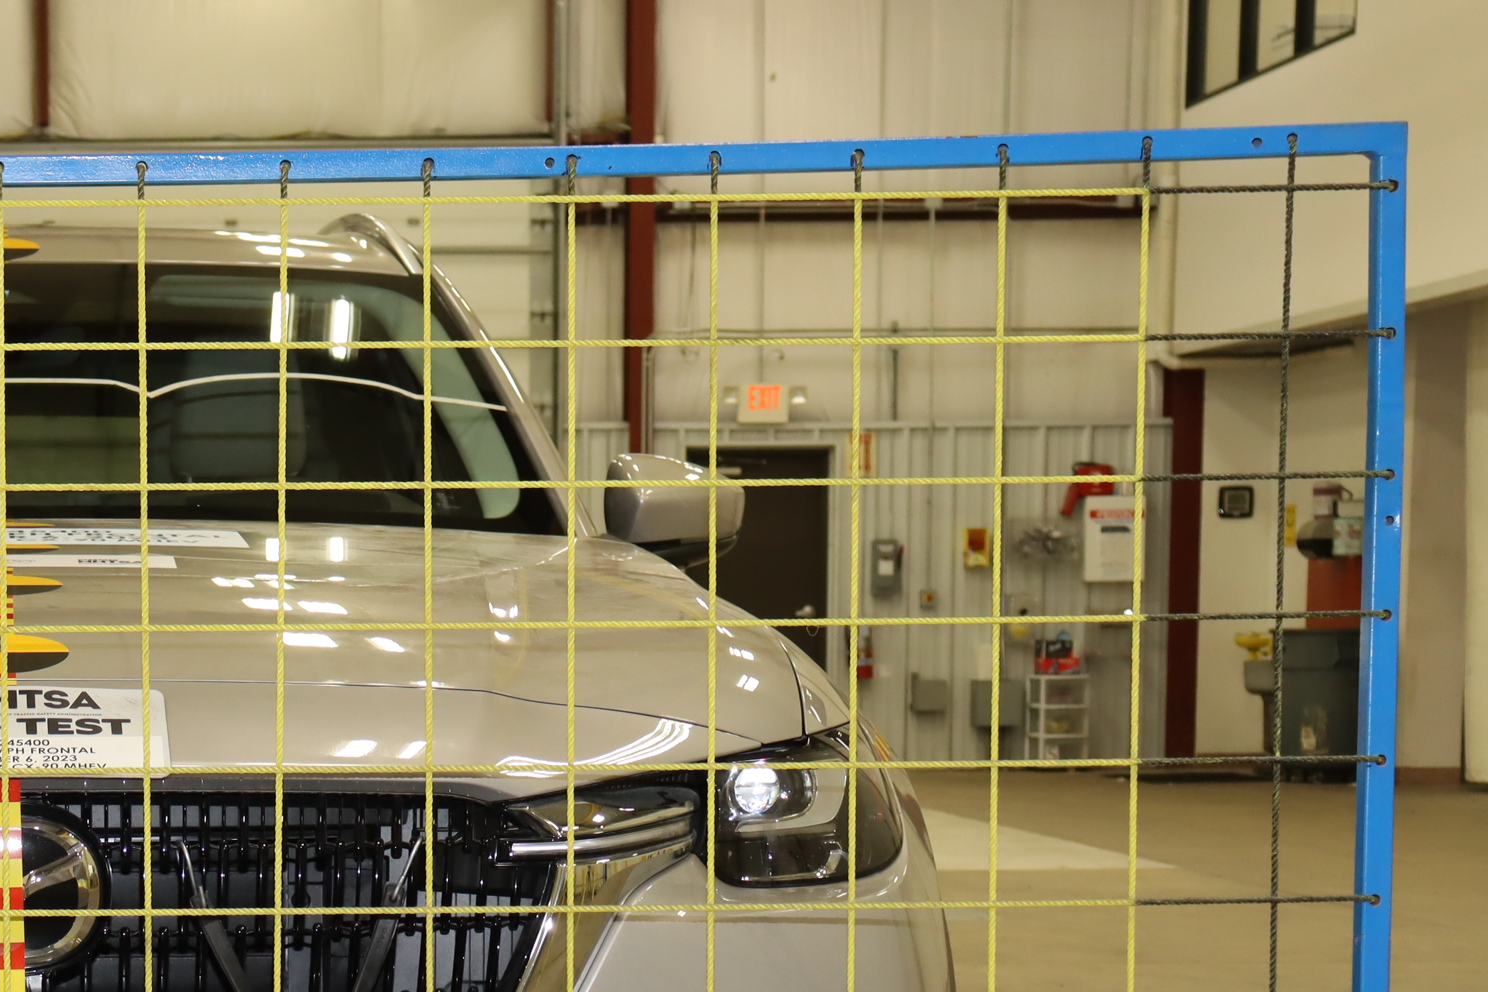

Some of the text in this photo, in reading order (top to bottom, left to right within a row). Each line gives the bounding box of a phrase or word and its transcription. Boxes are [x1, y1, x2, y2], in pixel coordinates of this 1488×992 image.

[748, 385, 782, 410] EXIT
[16, 717, 131, 735] TEST
[25, 755, 37, 763] 6,
